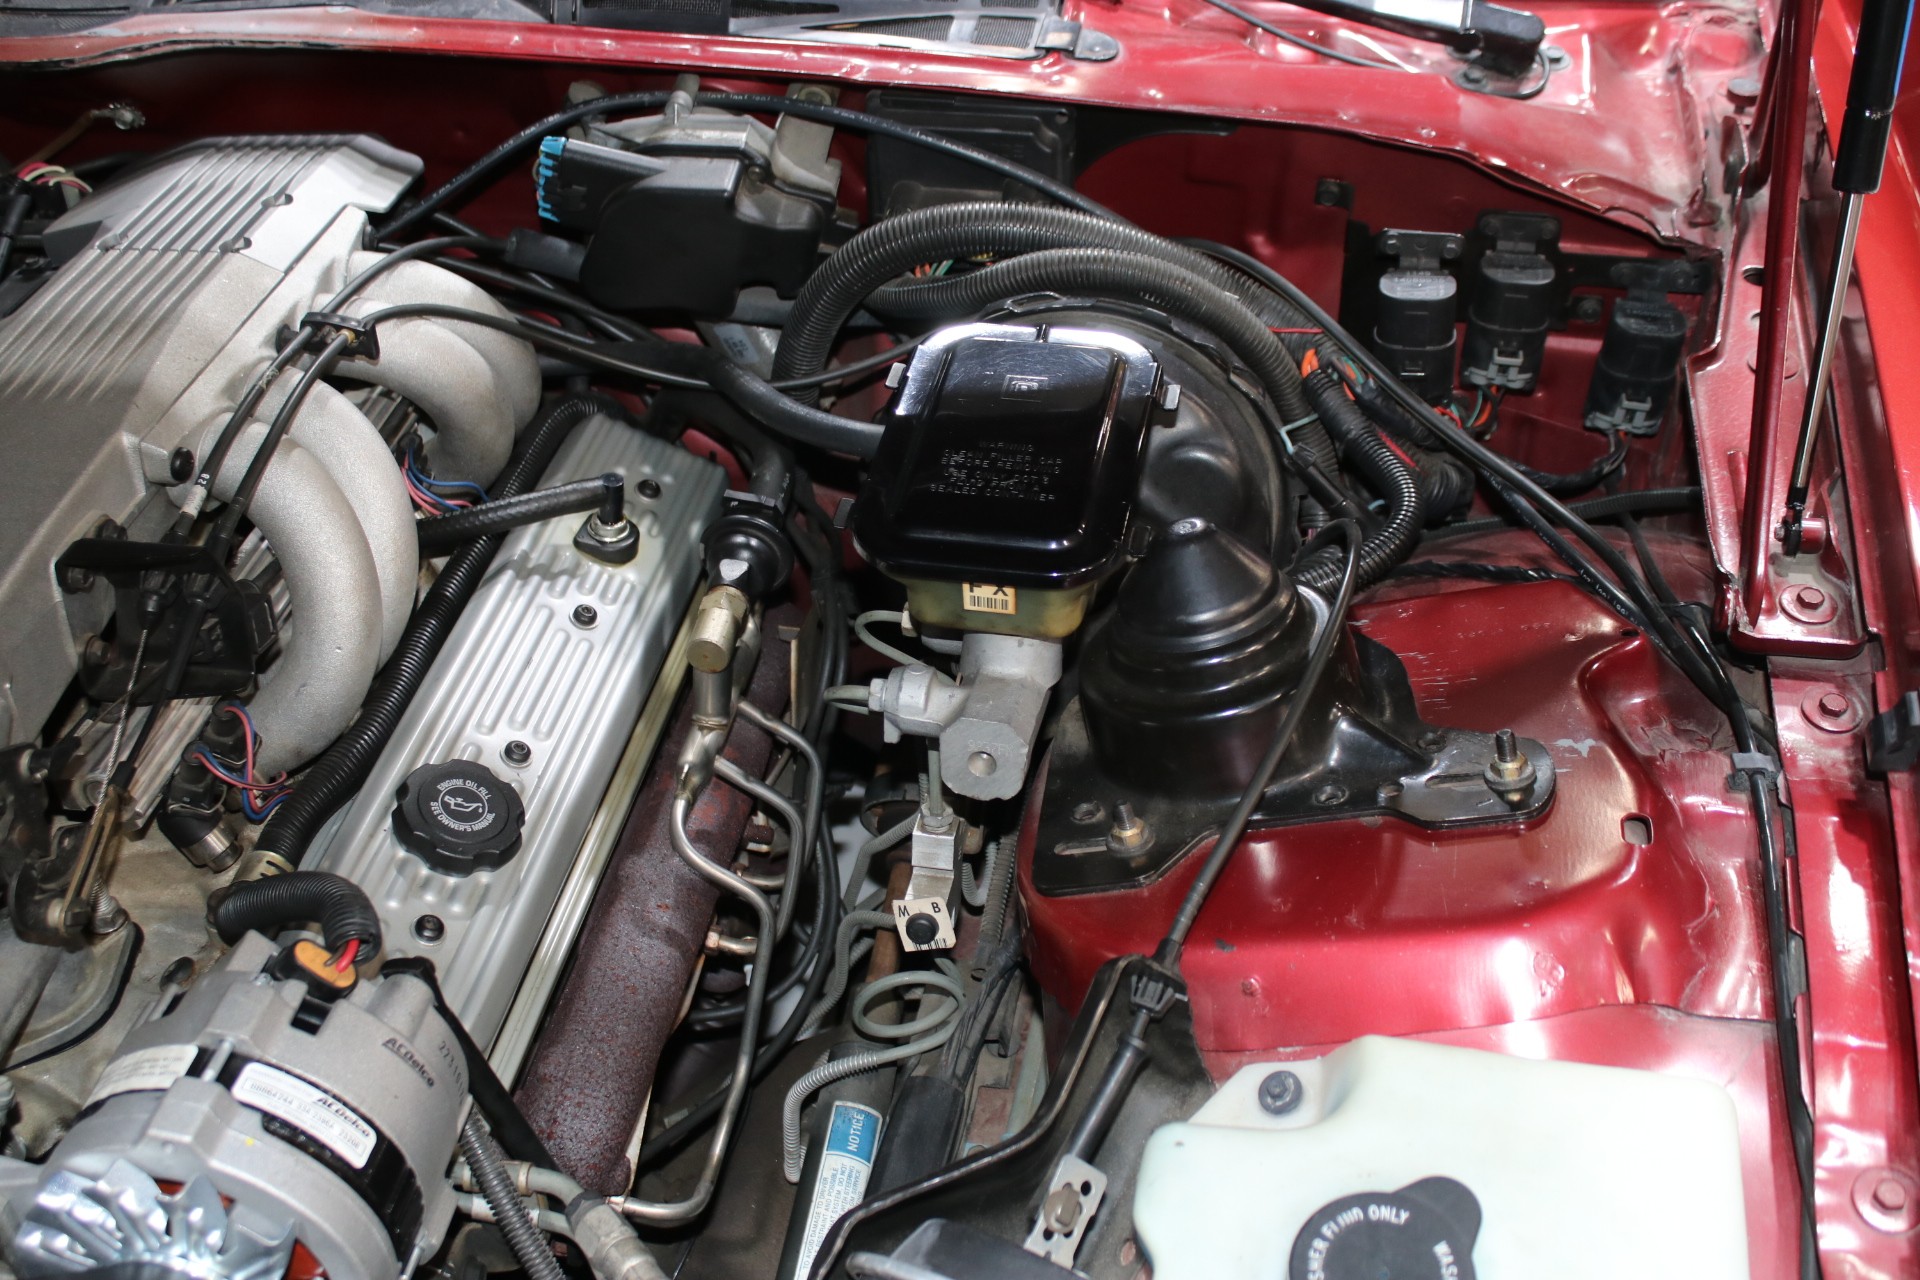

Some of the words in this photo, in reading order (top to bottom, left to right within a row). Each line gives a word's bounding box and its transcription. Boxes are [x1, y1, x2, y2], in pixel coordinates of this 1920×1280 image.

[944, 449, 984, 459] CLEAN
[990, 452, 1032, 462] FILLER
[1039, 456, 1063, 465] CAP
[979, 442, 1034, 451] WARNING
[941, 457, 990, 468] BEFORE
[997, 461, 1060, 474] REMOVING
[1013, 474, 1039, 483] DOT
[929, 483, 978, 495] SEALED
[984, 488, 1057, 502] CONTAINER
[437, 779, 464, 791] ENGINE
[465, 780, 478, 790] OIL
[478, 786, 492, 800] FILL
[430, 801, 441, 815] SEE
[437, 815, 472, 832] OWNER'S
[472, 812, 496, 831] MANUAL
[898, 905, 910, 917] M
[931, 902, 941, 914] B
[847, 1111, 865, 1152] NOTICE
[845, 1165, 855, 1195] STEERING
[852, 1169, 862, 1196] SERVICE
[806, 1239, 814, 1260] AVOID
[811, 1212, 821, 1239] DAMAGE
[819, 1177, 827, 1200] DRIVER
[816, 1214, 828, 1249] RESTRAINT
[827, 1167, 838, 1200] POSSIBLE
[1367, 1204, 1410, 1225] ONLY
